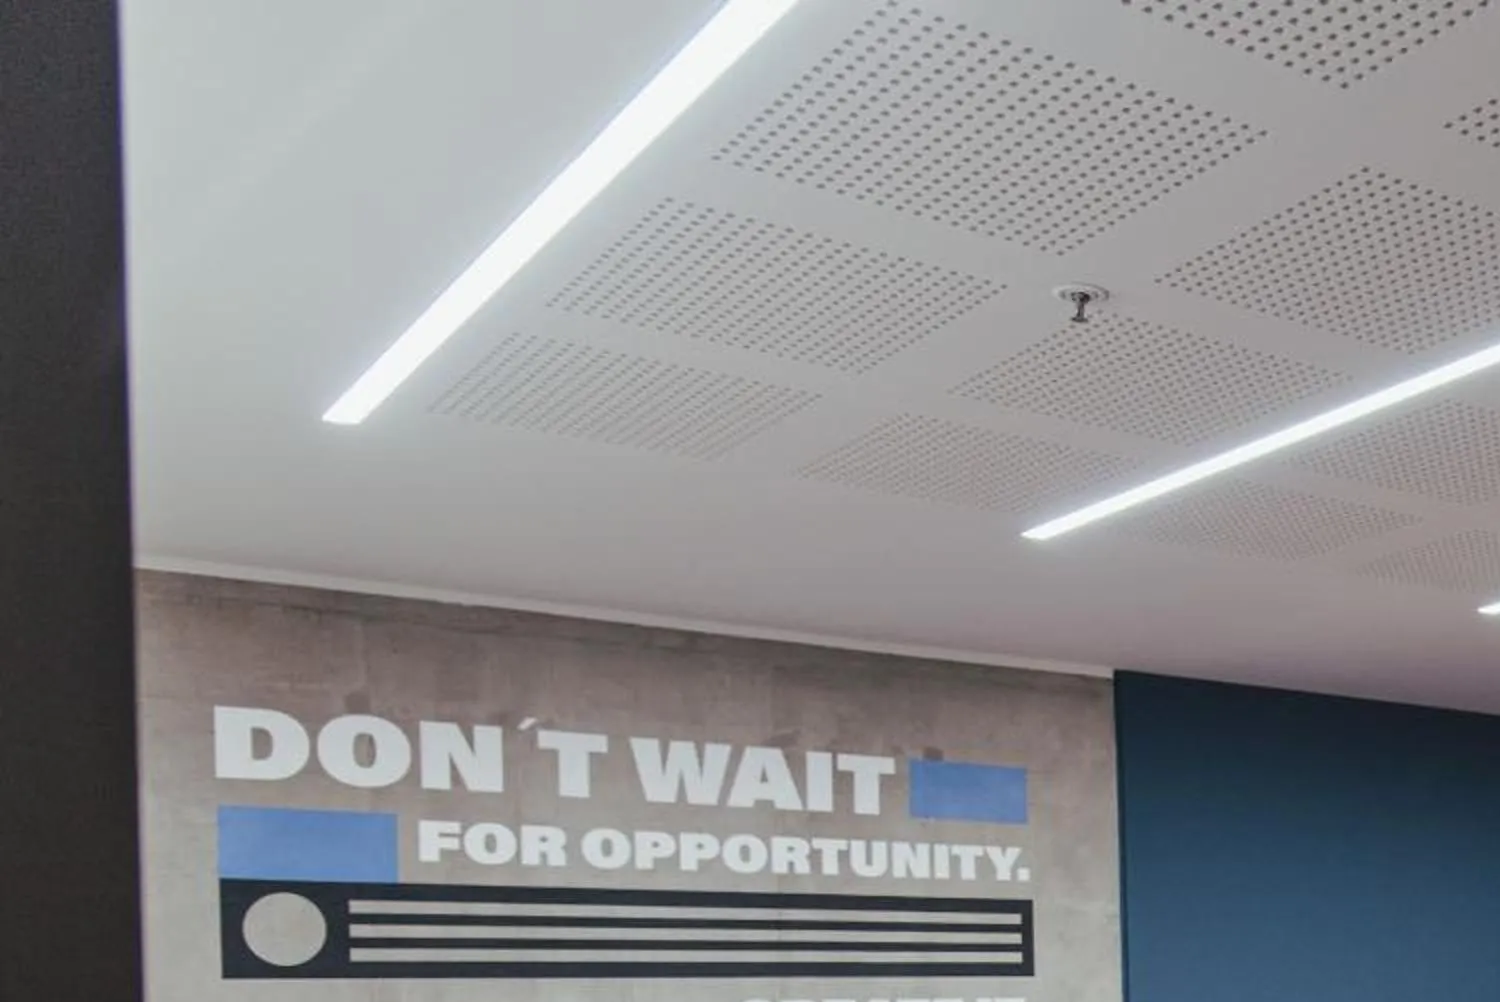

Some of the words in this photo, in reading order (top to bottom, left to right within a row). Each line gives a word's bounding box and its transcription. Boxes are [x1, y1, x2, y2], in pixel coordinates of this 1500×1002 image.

[629, 737, 897, 815] WAIT
[418, 819, 567, 867] FOR
[581, 827, 1031, 882] OPPORTUNITY.
